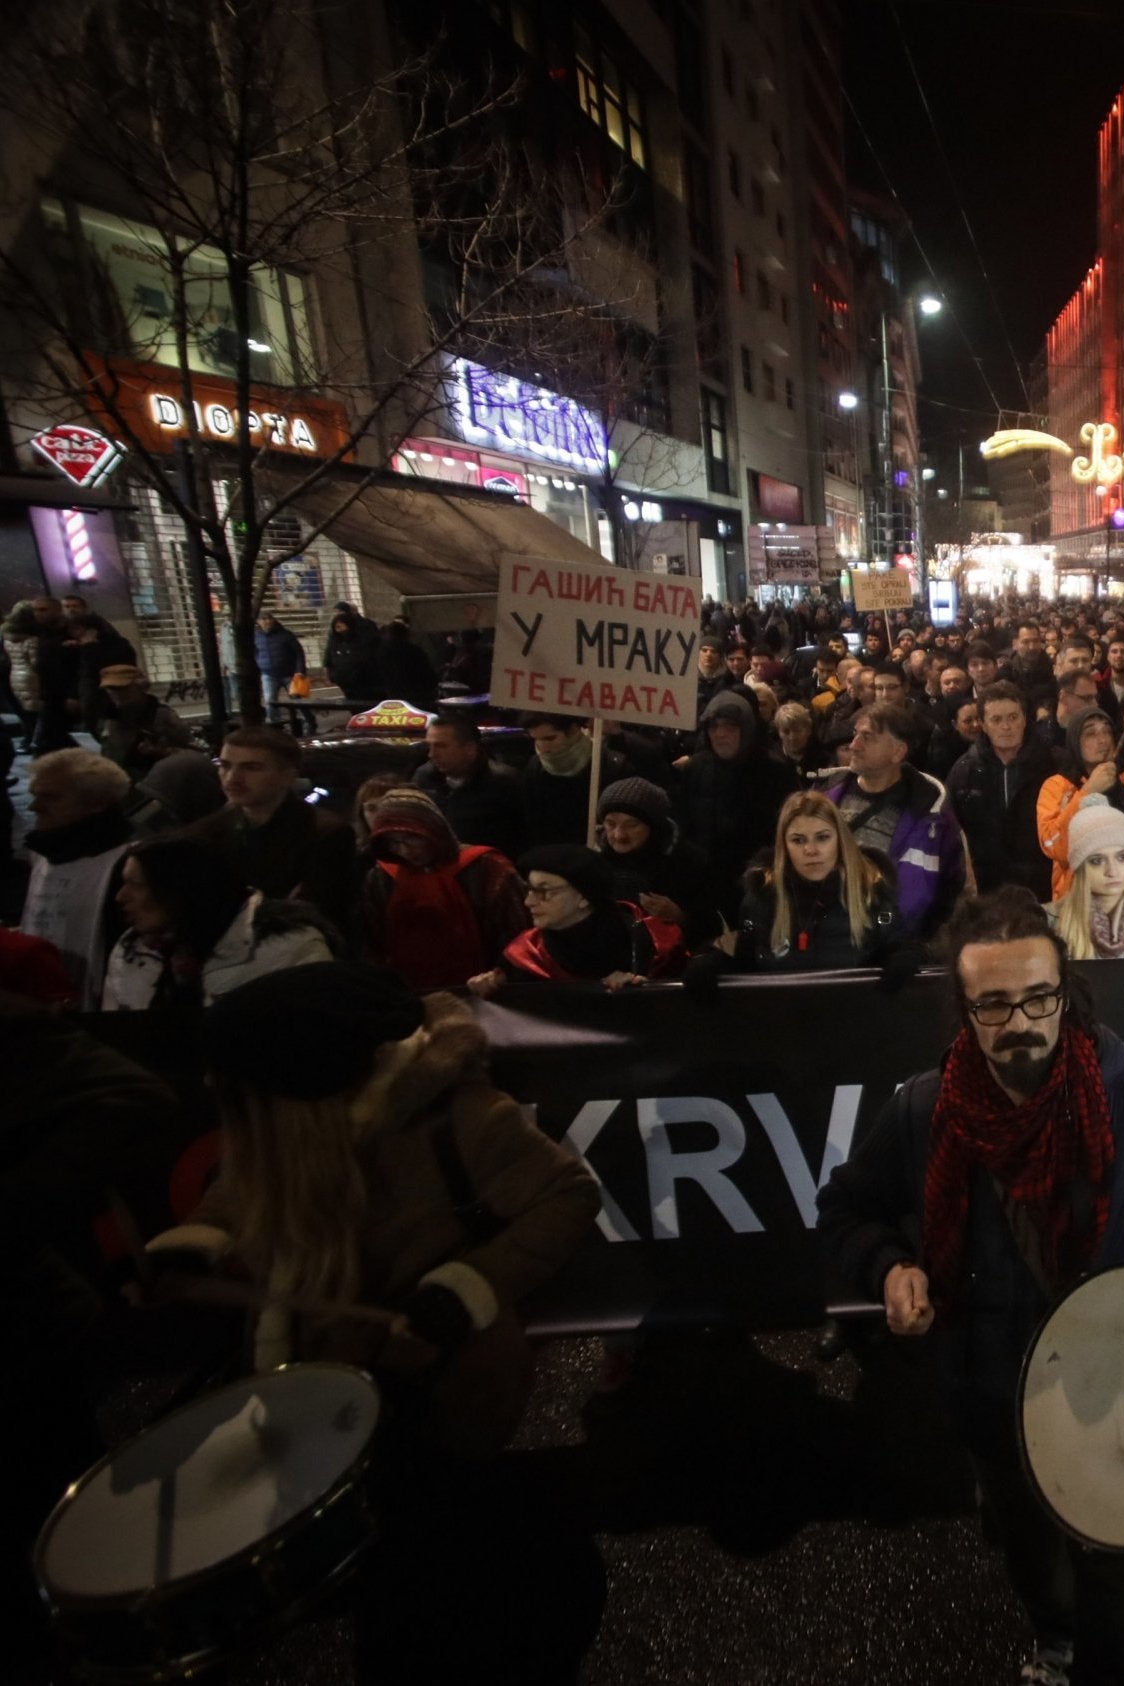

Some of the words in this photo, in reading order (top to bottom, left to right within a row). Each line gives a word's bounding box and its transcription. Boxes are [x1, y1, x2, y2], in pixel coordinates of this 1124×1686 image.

[512, 564, 626, 609] ГАШИЋ
[632, 580, 700, 620] БАТА
[510, 611, 544, 657] У
[576, 618, 698, 677] МРАКУ
[504, 667, 547, 703] ТЕ
[556, 676, 680, 717] САВАТА
[370, 715, 408, 726] TAXI
